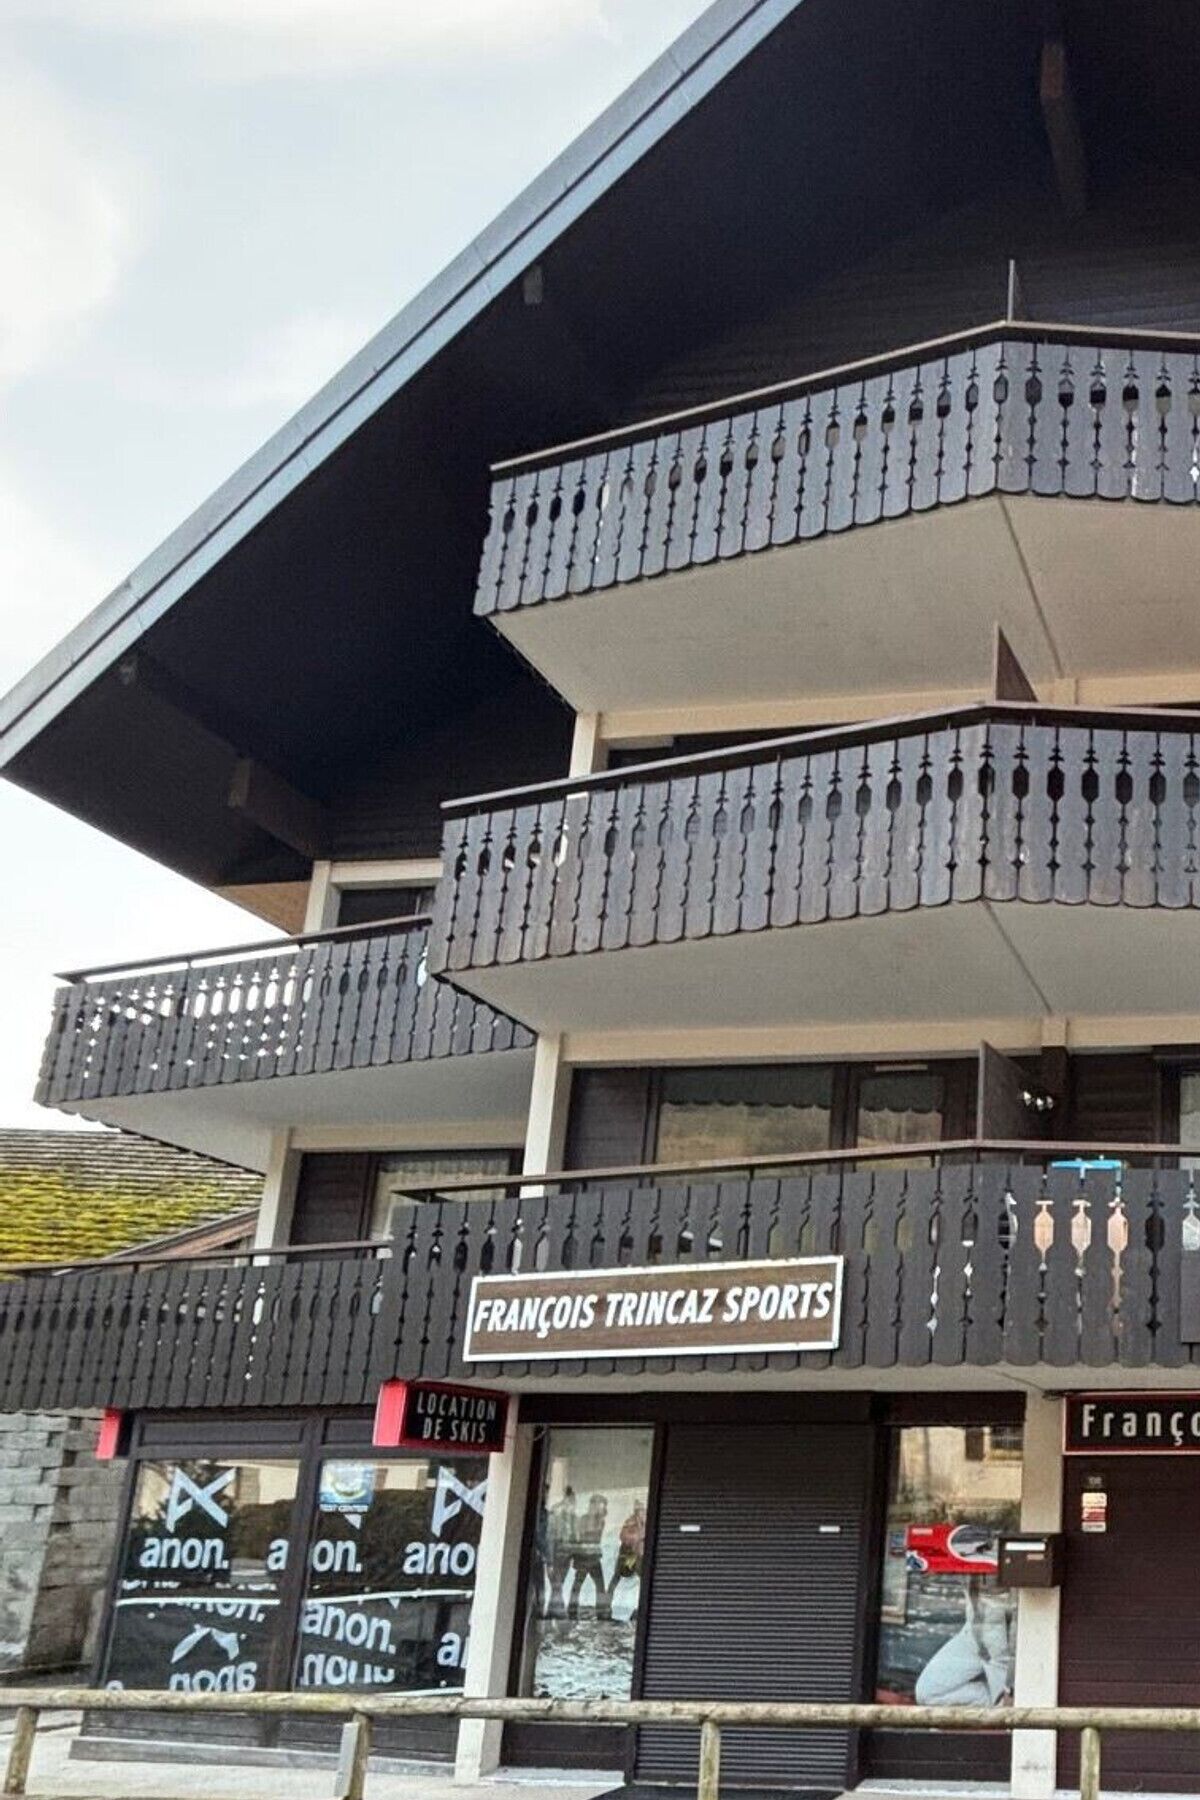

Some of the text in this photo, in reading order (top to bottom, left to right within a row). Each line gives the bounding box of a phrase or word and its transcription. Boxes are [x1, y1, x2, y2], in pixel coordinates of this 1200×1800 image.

[473, 1282, 833, 1338] FRANÇOIS TRINCAZ SPORTS
[417, 1391, 497, 1420] LOCATION
[422, 1417, 487, 1443] DE SKIS
[139, 1536, 230, 1570] anon.
[403, 1541, 476, 1576] ano
